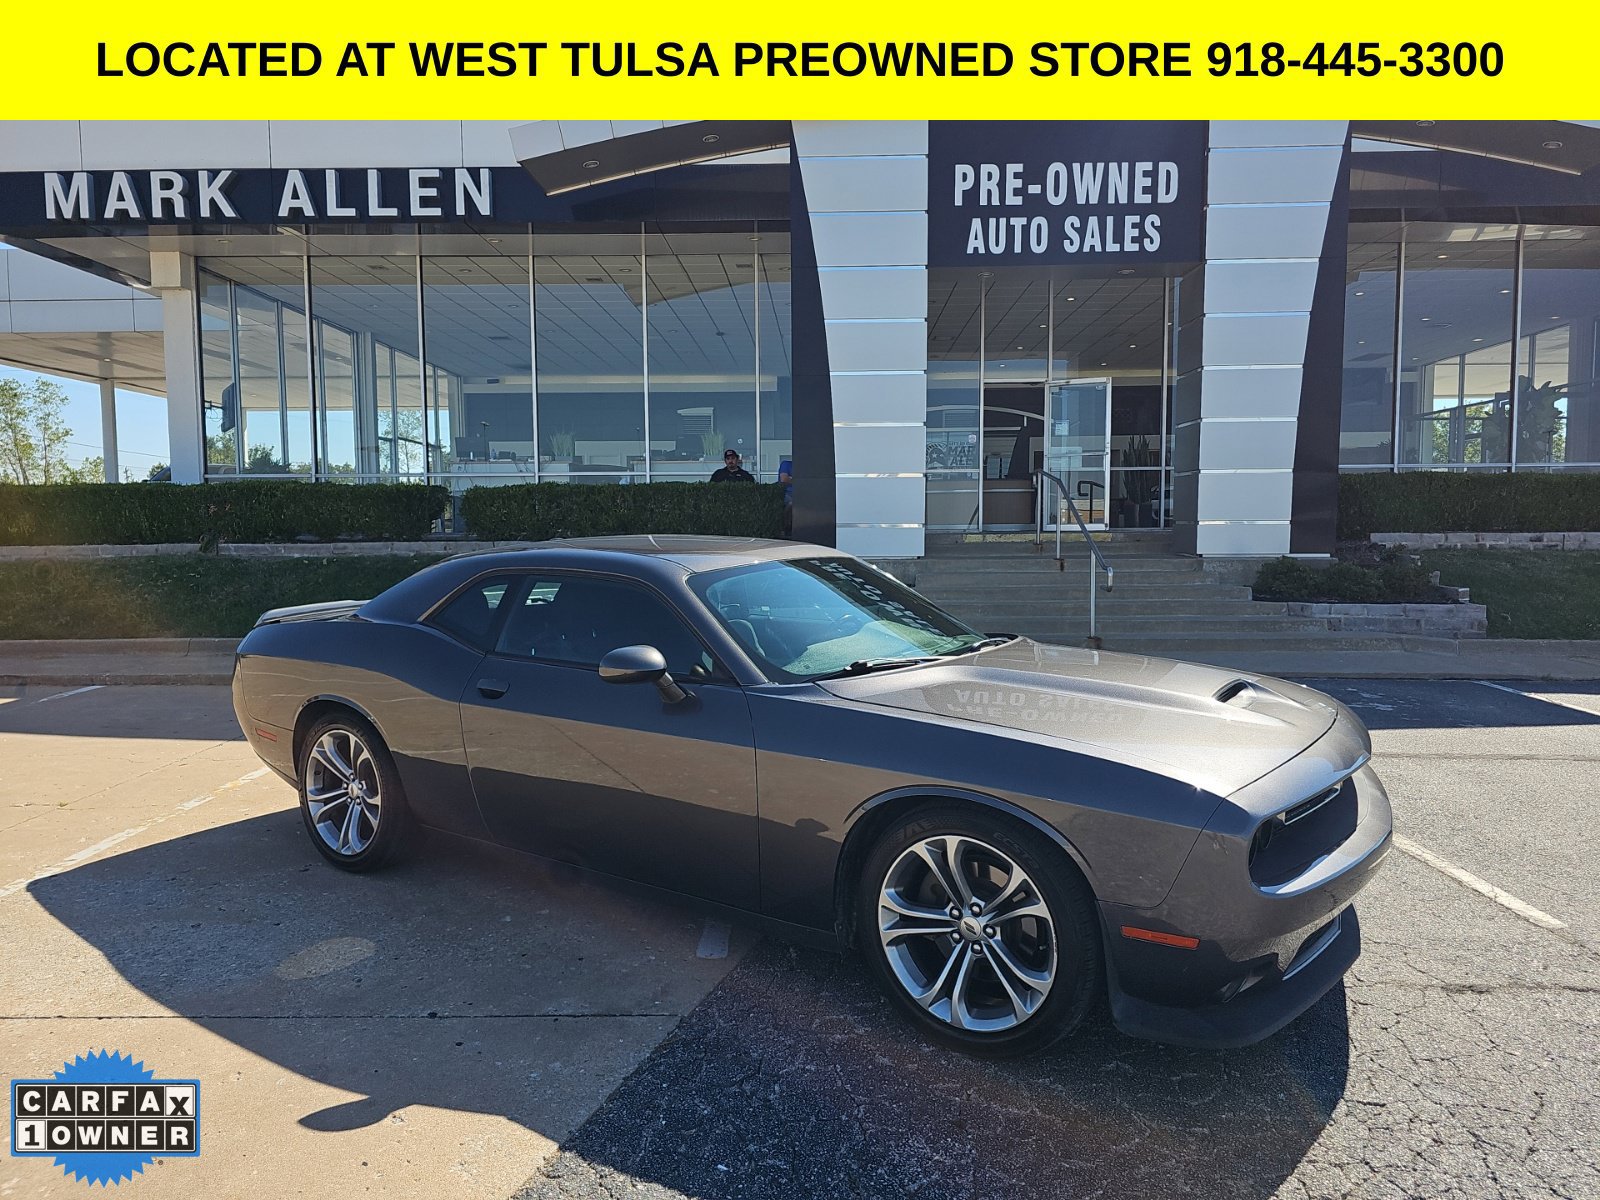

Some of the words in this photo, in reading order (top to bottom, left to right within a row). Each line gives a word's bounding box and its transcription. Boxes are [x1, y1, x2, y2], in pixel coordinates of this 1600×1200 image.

[44, 169, 239, 220] MARK
[277, 167, 493, 218] ALLEN
[954, 161, 1179, 206] PRE-OWNED
[966, 215, 1049, 254] AUTO
[1063, 214, 1162, 254] SALES
